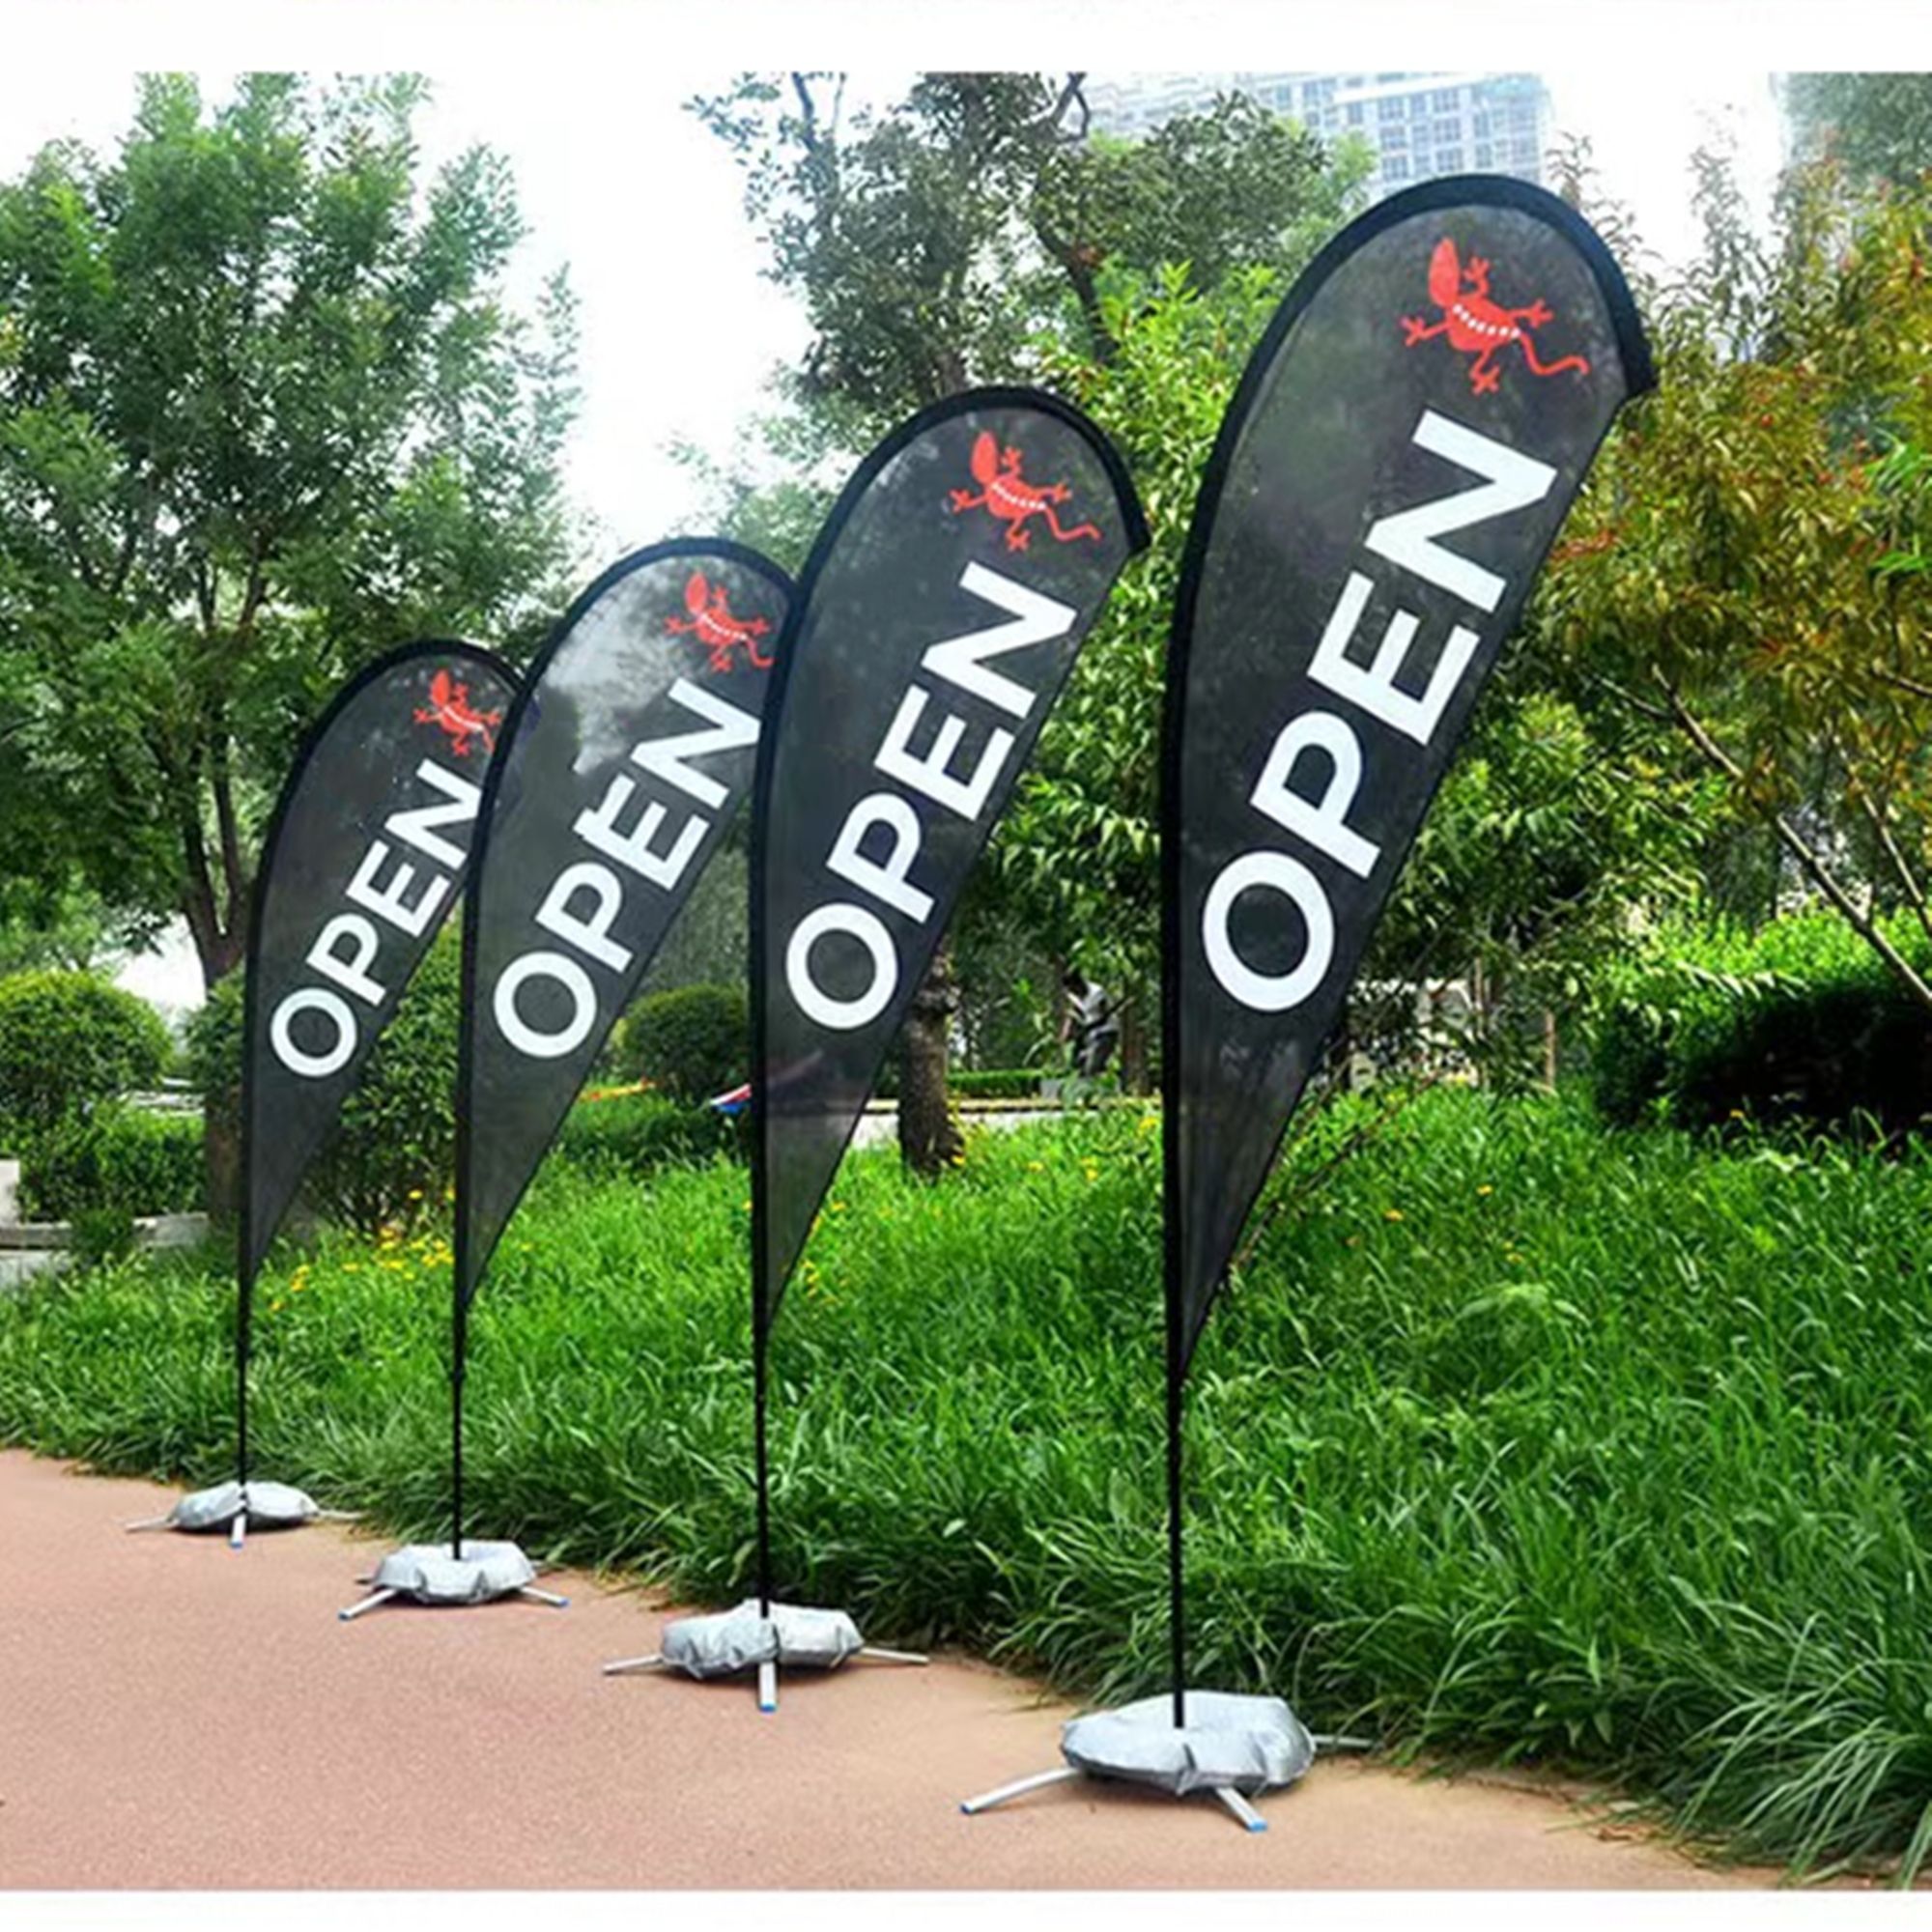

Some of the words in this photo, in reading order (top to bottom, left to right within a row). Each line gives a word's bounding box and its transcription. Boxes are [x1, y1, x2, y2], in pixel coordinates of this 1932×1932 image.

[270, 758, 482, 1076] OPEN
[494, 678, 761, 1058] OPEN
[786, 562, 1077, 1030] OPEN
[1202, 411, 1558, 1012] OPEN
